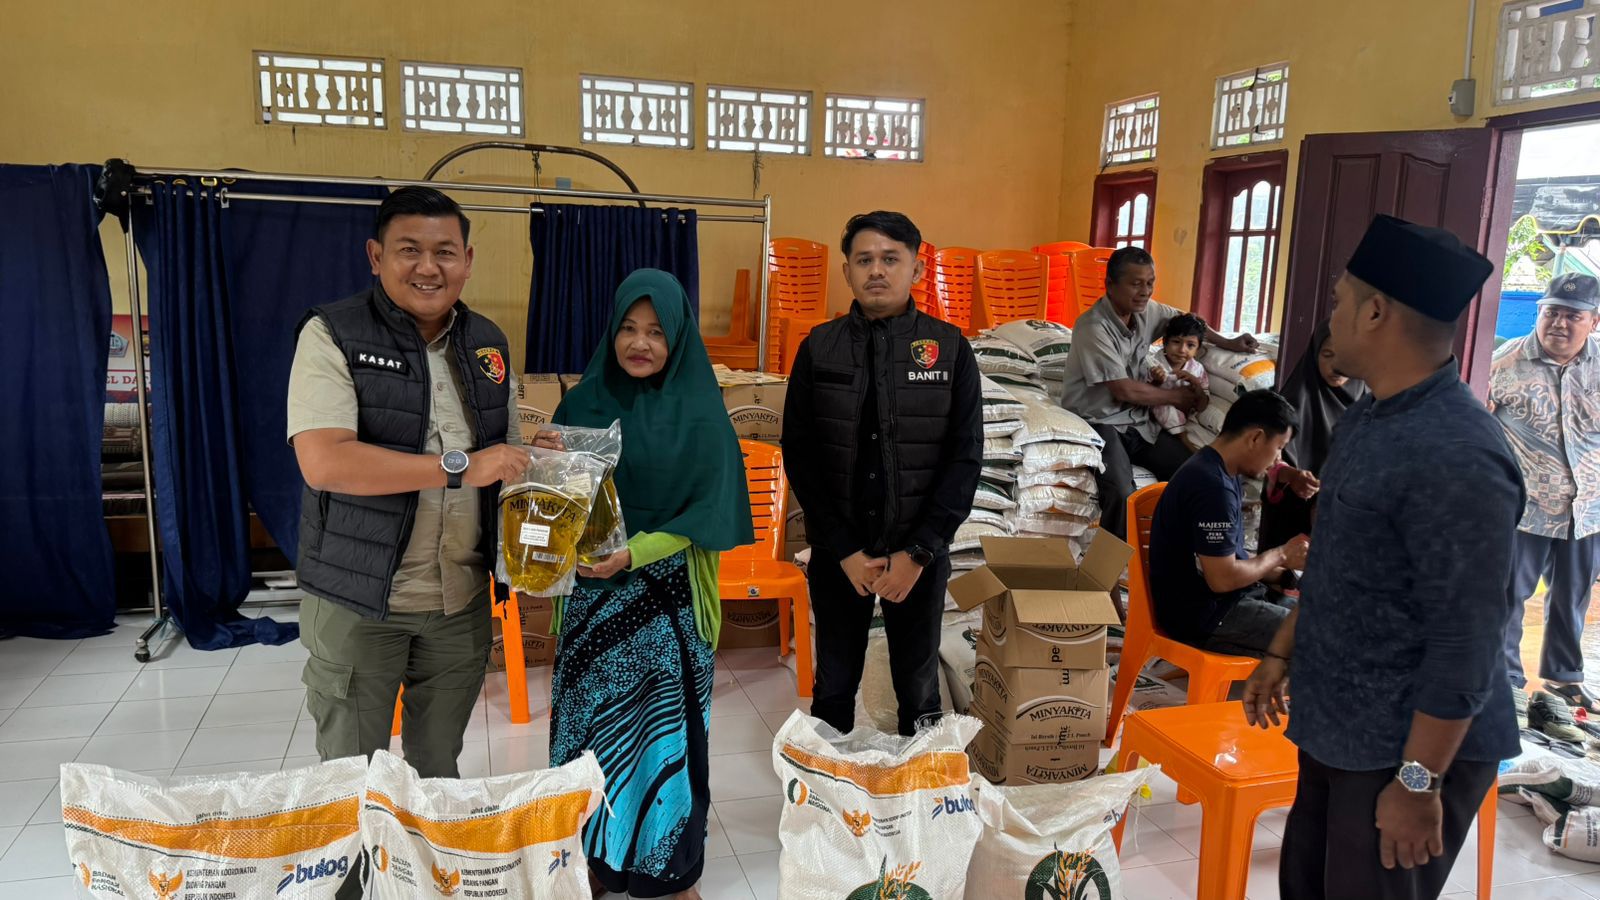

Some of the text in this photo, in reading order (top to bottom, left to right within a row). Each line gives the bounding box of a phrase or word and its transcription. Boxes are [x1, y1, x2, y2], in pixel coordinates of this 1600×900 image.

[359, 353, 402, 369] KASAT
[908, 371, 941, 381] BANIT
[733, 412, 779, 424] MINYAKITA
[1029, 706, 1092, 722] MINYAKITA
[1026, 763, 1088, 780] MINYAKITA
[92, 870, 116, 880] BADAN
[296, 855, 348, 884] bulog
